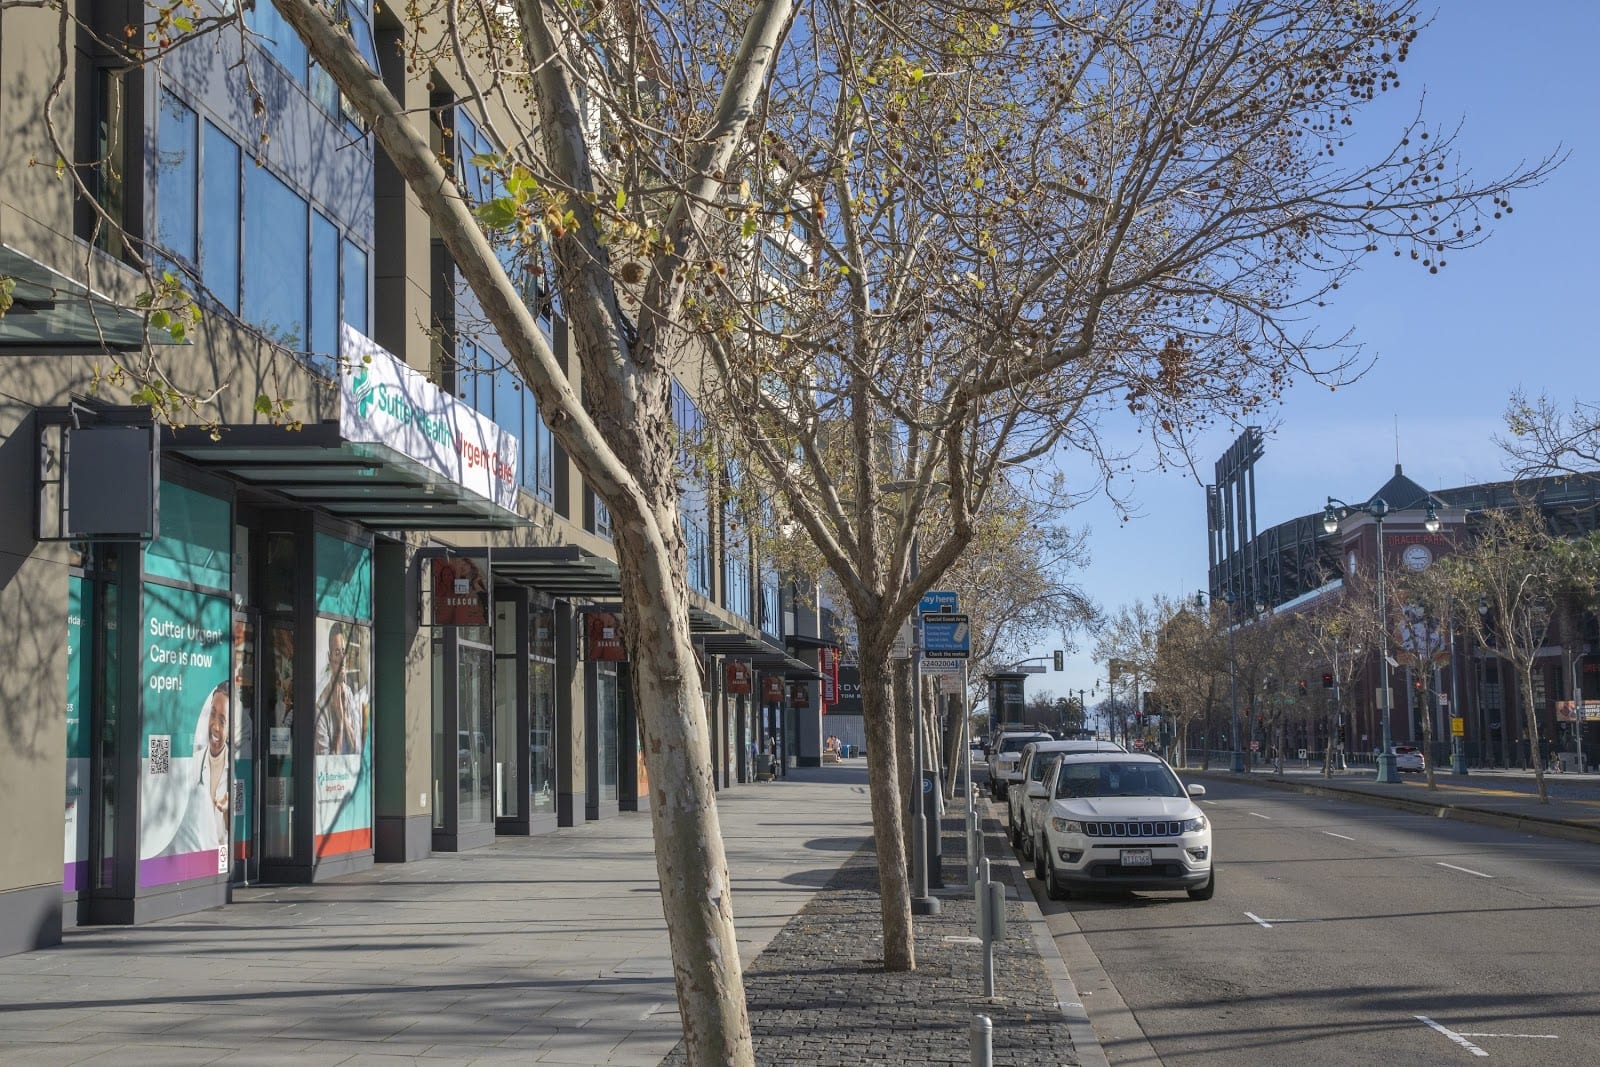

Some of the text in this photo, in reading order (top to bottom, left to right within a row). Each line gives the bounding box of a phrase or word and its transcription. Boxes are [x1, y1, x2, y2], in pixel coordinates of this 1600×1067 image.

[456, 431, 490, 469] Urgent
[491, 451, 513, 484] Care
[447, 598, 478, 606] BEACON
[936, 594, 955, 603] here
[150, 617, 223, 647] Sutter Urgent
[150, 644, 213, 668] Care is now
[149, 674, 183, 694] open!
